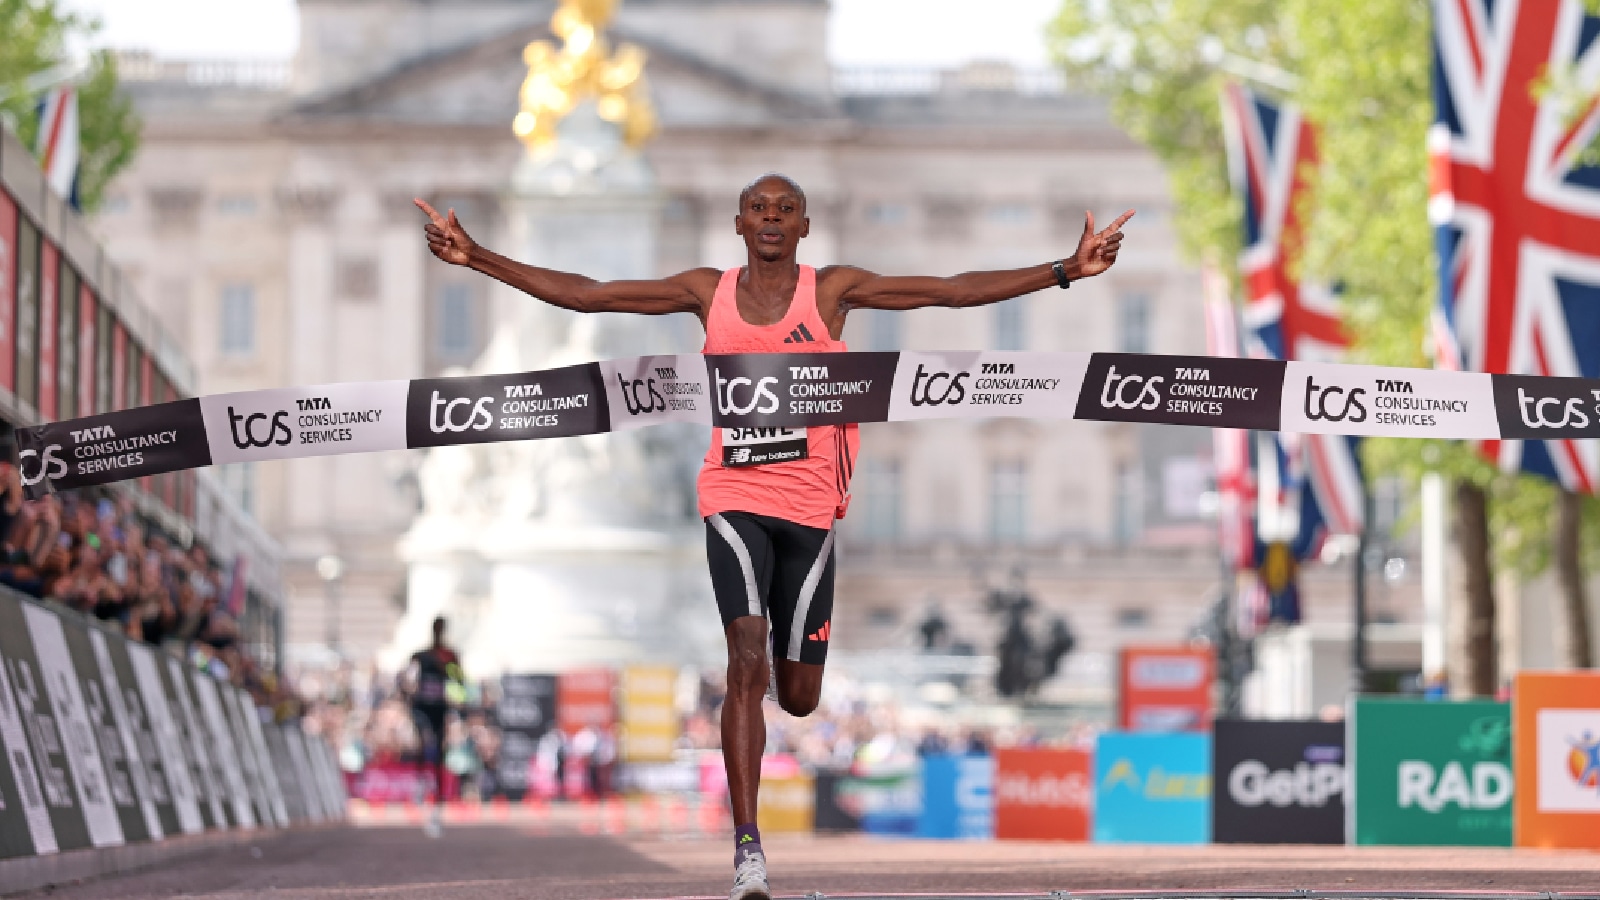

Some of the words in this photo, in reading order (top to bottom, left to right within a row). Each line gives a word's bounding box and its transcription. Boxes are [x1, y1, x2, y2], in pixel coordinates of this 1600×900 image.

[789, 366, 829, 380] TATA
[981, 363, 1015, 375] TATA
[1175, 367, 1210, 381] TATA
[503, 384, 543, 398] TATA
[715, 367, 779, 416] tcs
[789, 379, 872, 398] CONSULTANCY
[910, 363, 970, 407] tcs
[975, 377, 1060, 391] CONSULTANCY
[1100, 365, 1164, 411] tcs
[1169, 382, 1258, 401] CONSULTANCY
[1375, 379, 1413, 392] TATA
[618, 373, 666, 415] tcs
[969, 393, 1024, 405] SERVICES
[1304, 375, 1366, 422] tcs
[295, 397, 331, 411] TATA
[429, 390, 494, 434] tcs
[502, 393, 588, 414] CONSULTANCY
[789, 400, 843, 415] SERVICES
[1166, 400, 1223, 416] SERVICES
[1375, 396, 1468, 413] CONSULTANCY
[1517, 387, 1589, 429] tcs
[228, 406, 292, 449] tcs
[298, 409, 382, 428] CONSULTANCY
[500, 414, 558, 430] SERVICES
[1375, 412, 1436, 427] SERVICES
[70, 425, 116, 443] TATA
[299, 428, 353, 445] SERVICES
[74, 430, 177, 459] CONSULTANCY
[19, 443, 69, 487] cs
[77, 451, 144, 476] SERVICES
[751, 454, 767, 463] new
[768, 449, 800, 460] balance
